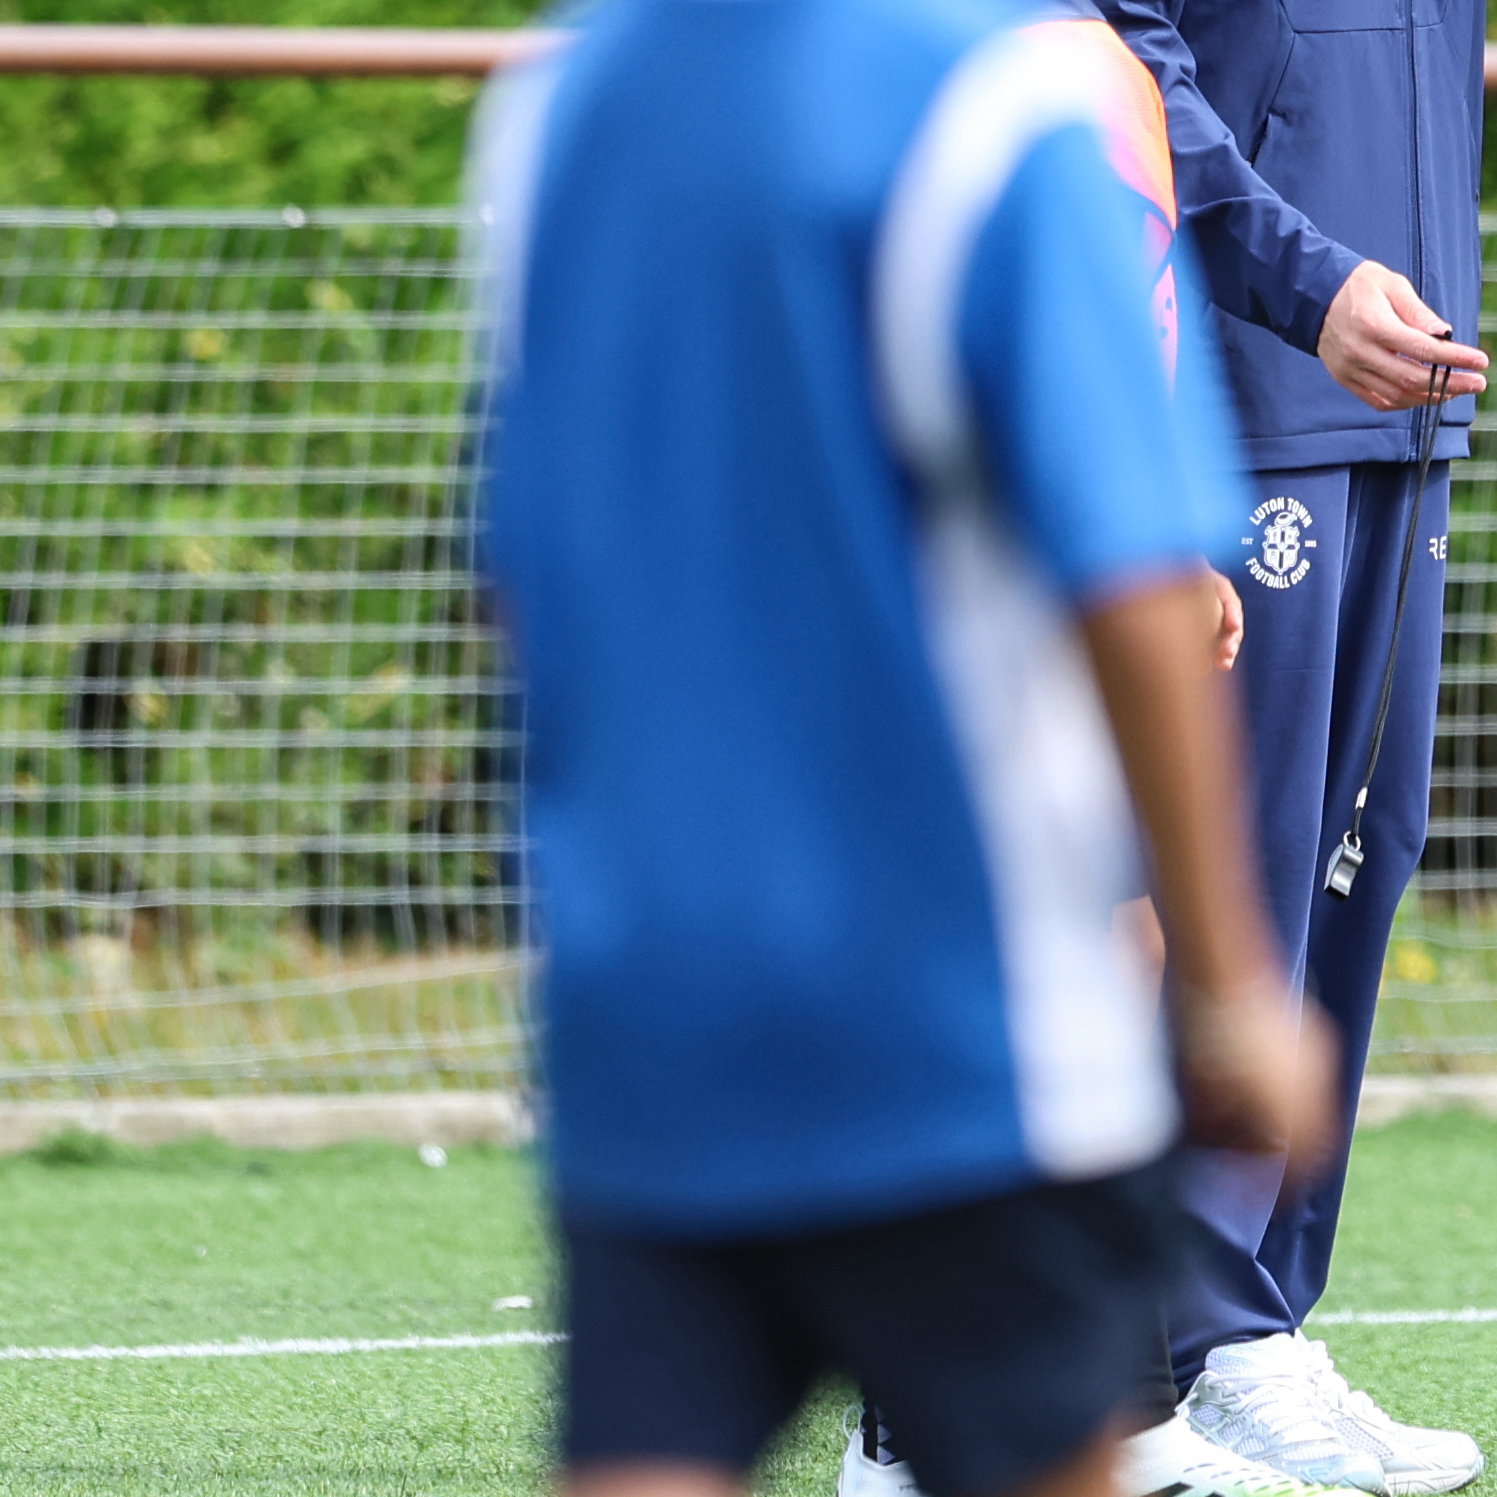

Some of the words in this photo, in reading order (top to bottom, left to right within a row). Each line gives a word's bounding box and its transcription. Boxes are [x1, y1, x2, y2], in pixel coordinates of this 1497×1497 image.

[1249, 496, 1285, 526] LUTON
[1287, 497, 1313, 528] TOWN
[1245, 557, 1290, 589] FOOTBALL
[1290, 558, 1311, 585] CLUB
